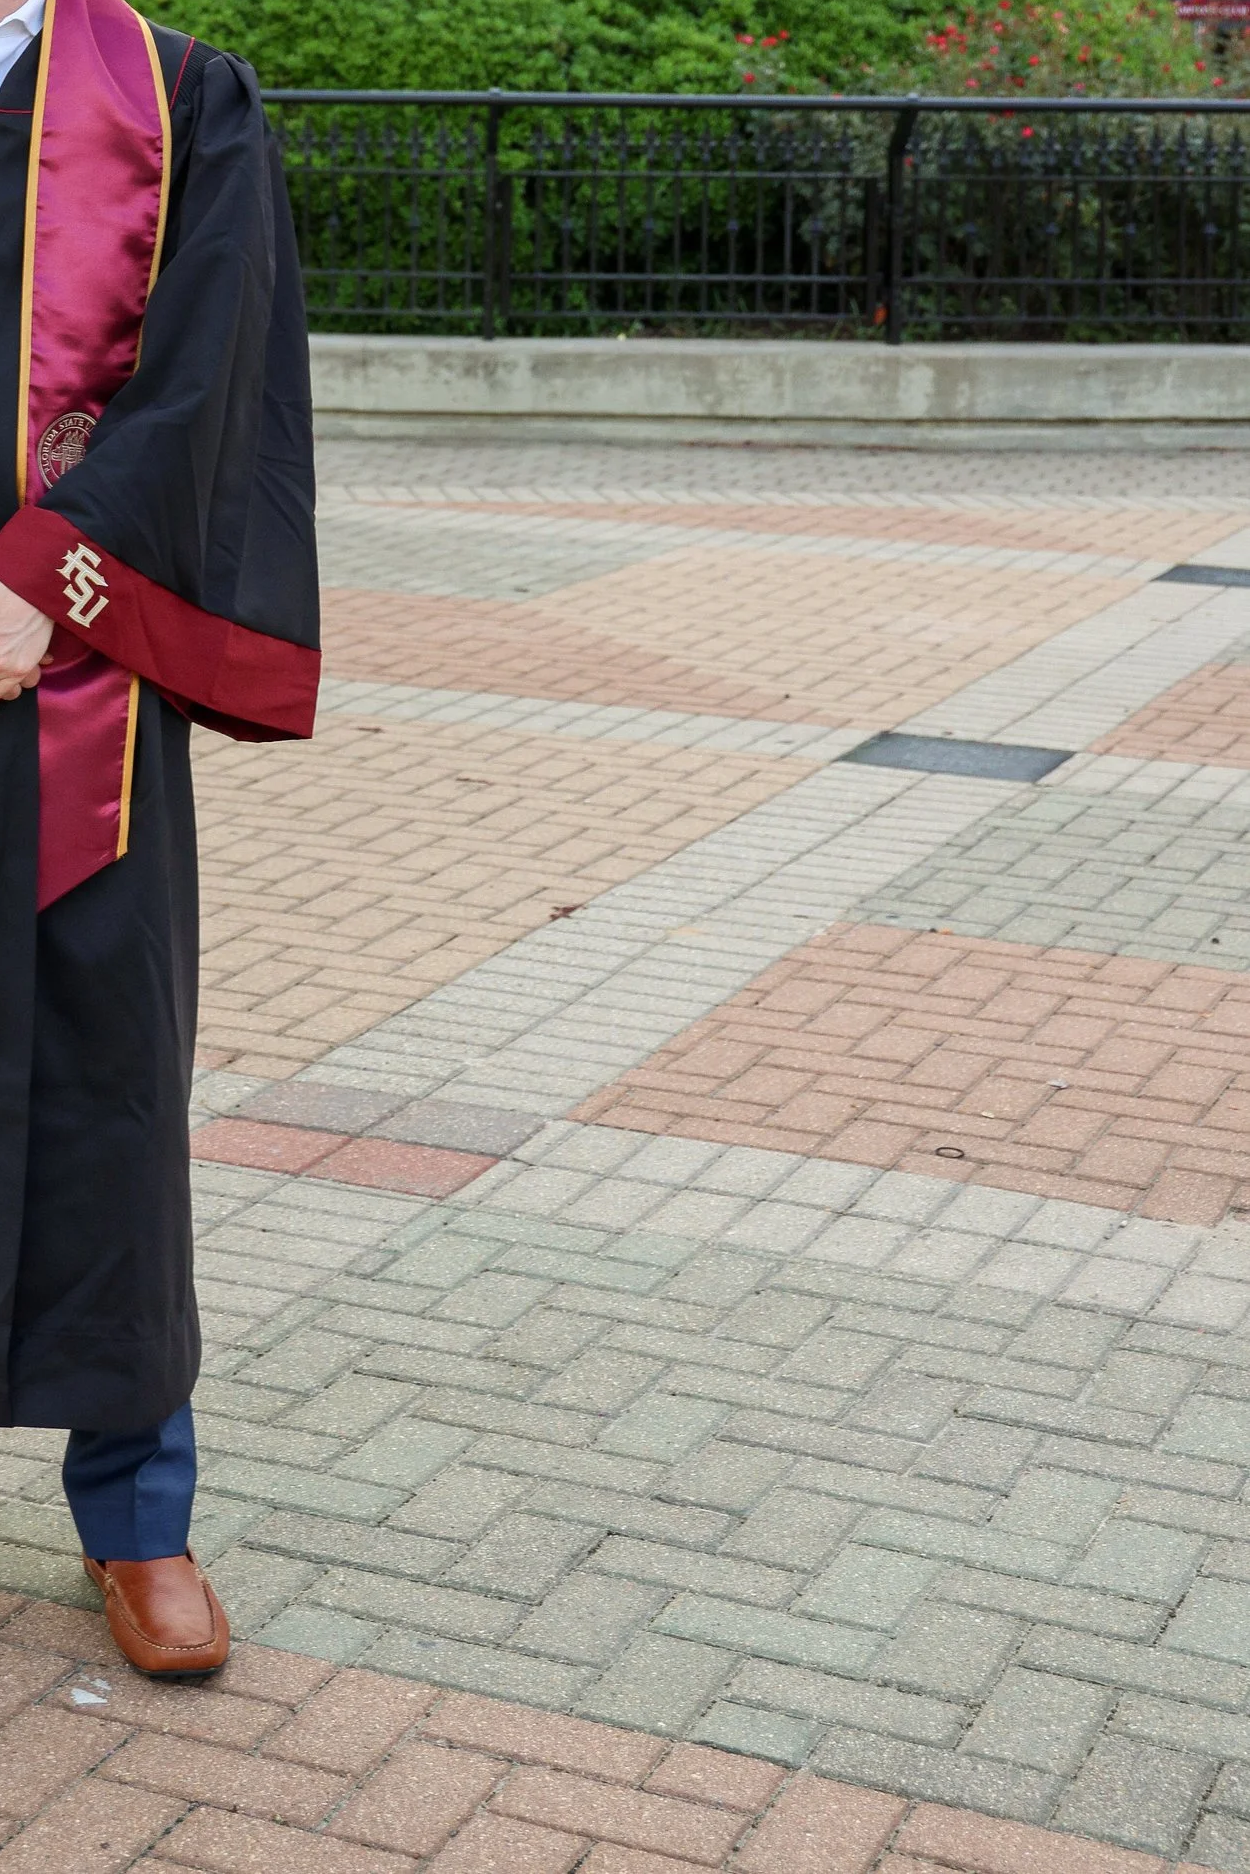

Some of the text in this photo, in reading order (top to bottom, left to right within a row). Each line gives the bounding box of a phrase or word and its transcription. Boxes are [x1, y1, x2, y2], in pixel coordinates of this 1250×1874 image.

[42, 417, 85, 473] FLORIDA STATE
[55, 542, 109, 629] FSU
